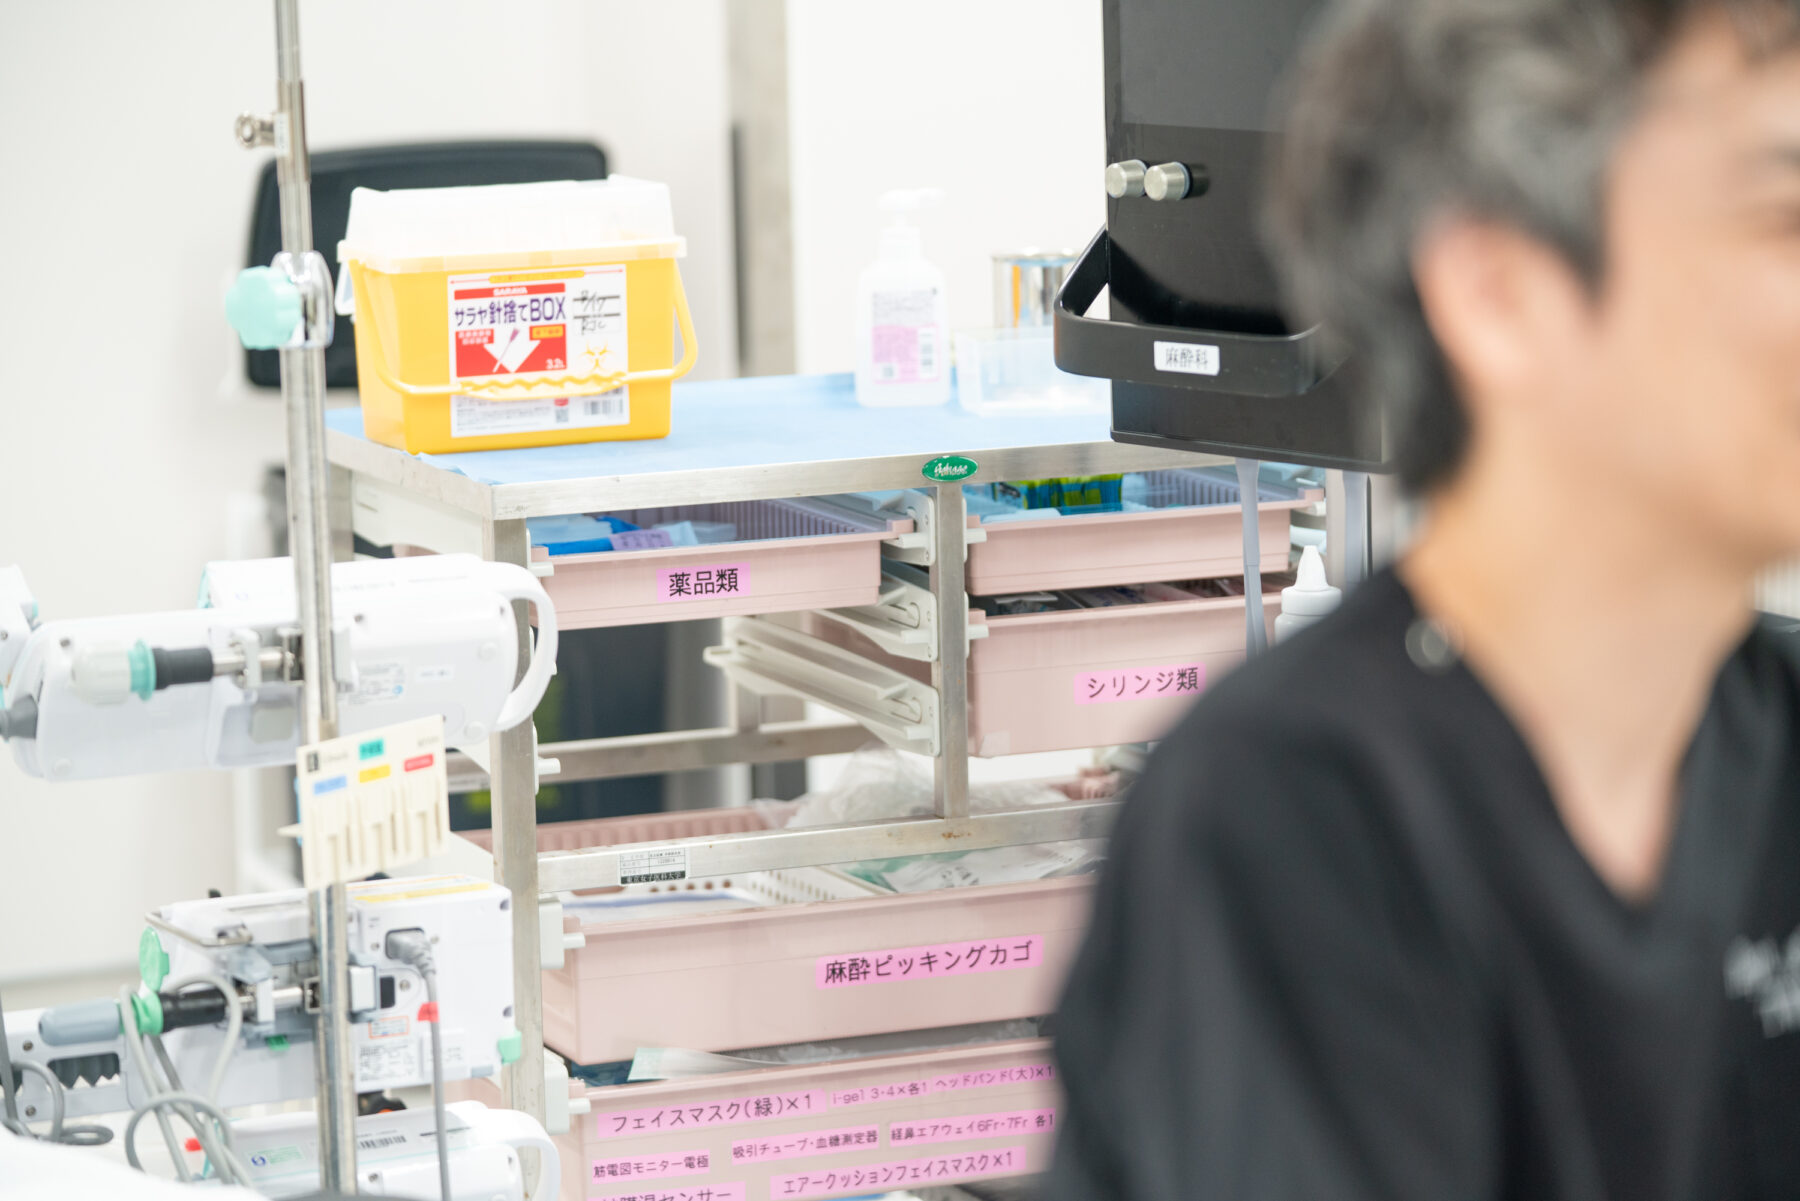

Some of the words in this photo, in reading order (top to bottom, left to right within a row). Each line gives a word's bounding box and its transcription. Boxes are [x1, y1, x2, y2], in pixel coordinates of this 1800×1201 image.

[455, 296, 566, 327] サラヤ針捨てBOX
[668, 567, 739, 597] 薬品類
[1088, 667, 1199, 698] シリンジ類
[825, 940, 1033, 984] 麻酔ピッキングカゴ
[593, 1154, 709, 1179] 筋電図モニター電極
[783, 1150, 1013, 1194] エアークッションフェイスマスク×1
